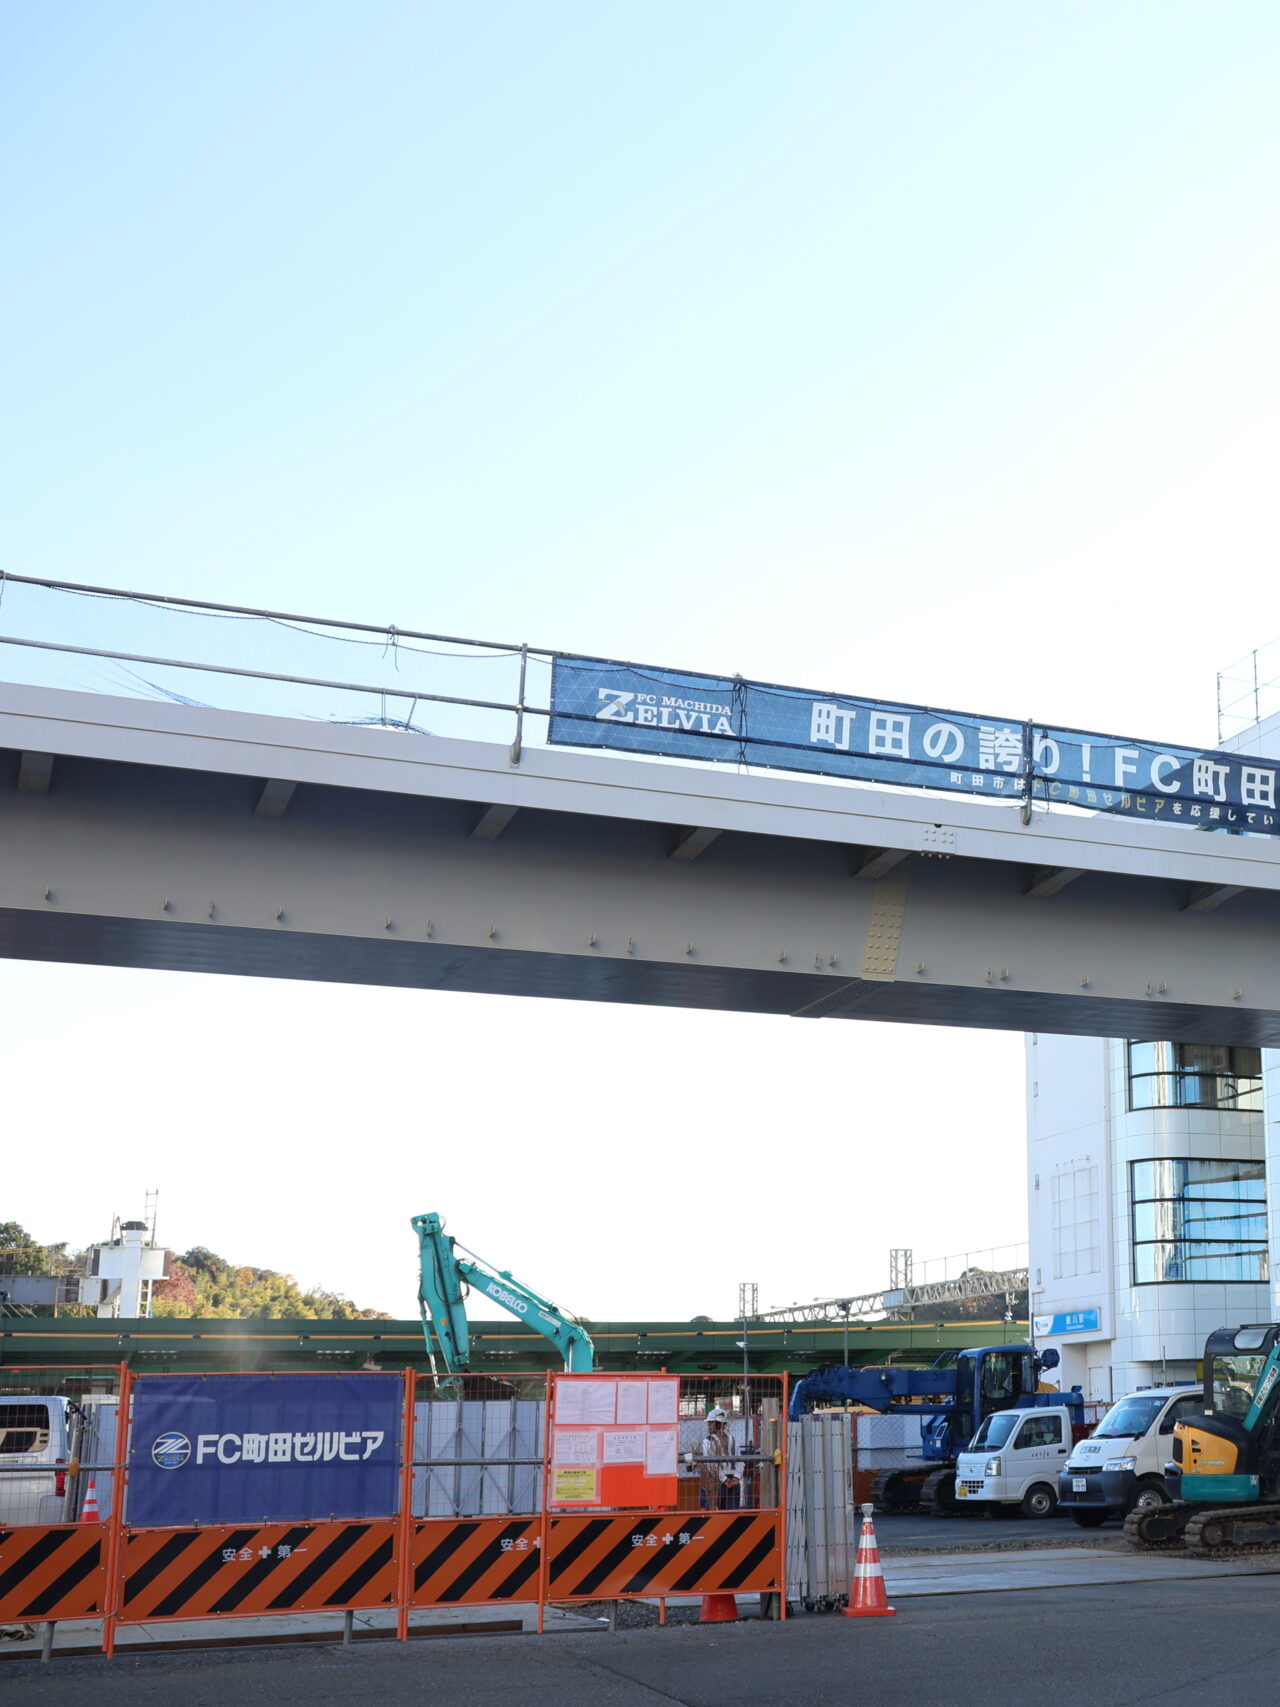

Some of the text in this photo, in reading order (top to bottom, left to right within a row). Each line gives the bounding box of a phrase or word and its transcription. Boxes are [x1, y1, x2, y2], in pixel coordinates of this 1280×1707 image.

[595, 687, 737, 736] ZELVIA
[636, 693, 733, 716] FC MACHIDA
[486, 1282, 528, 1314] KOBELCO
[196, 1431, 385, 1464] FC町田ゼルビア
[500, 1538, 529, 1551] 安全
[631, 1532, 705, 1547] 安全 第一
[222, 1544, 308, 1562] 安全 第一
